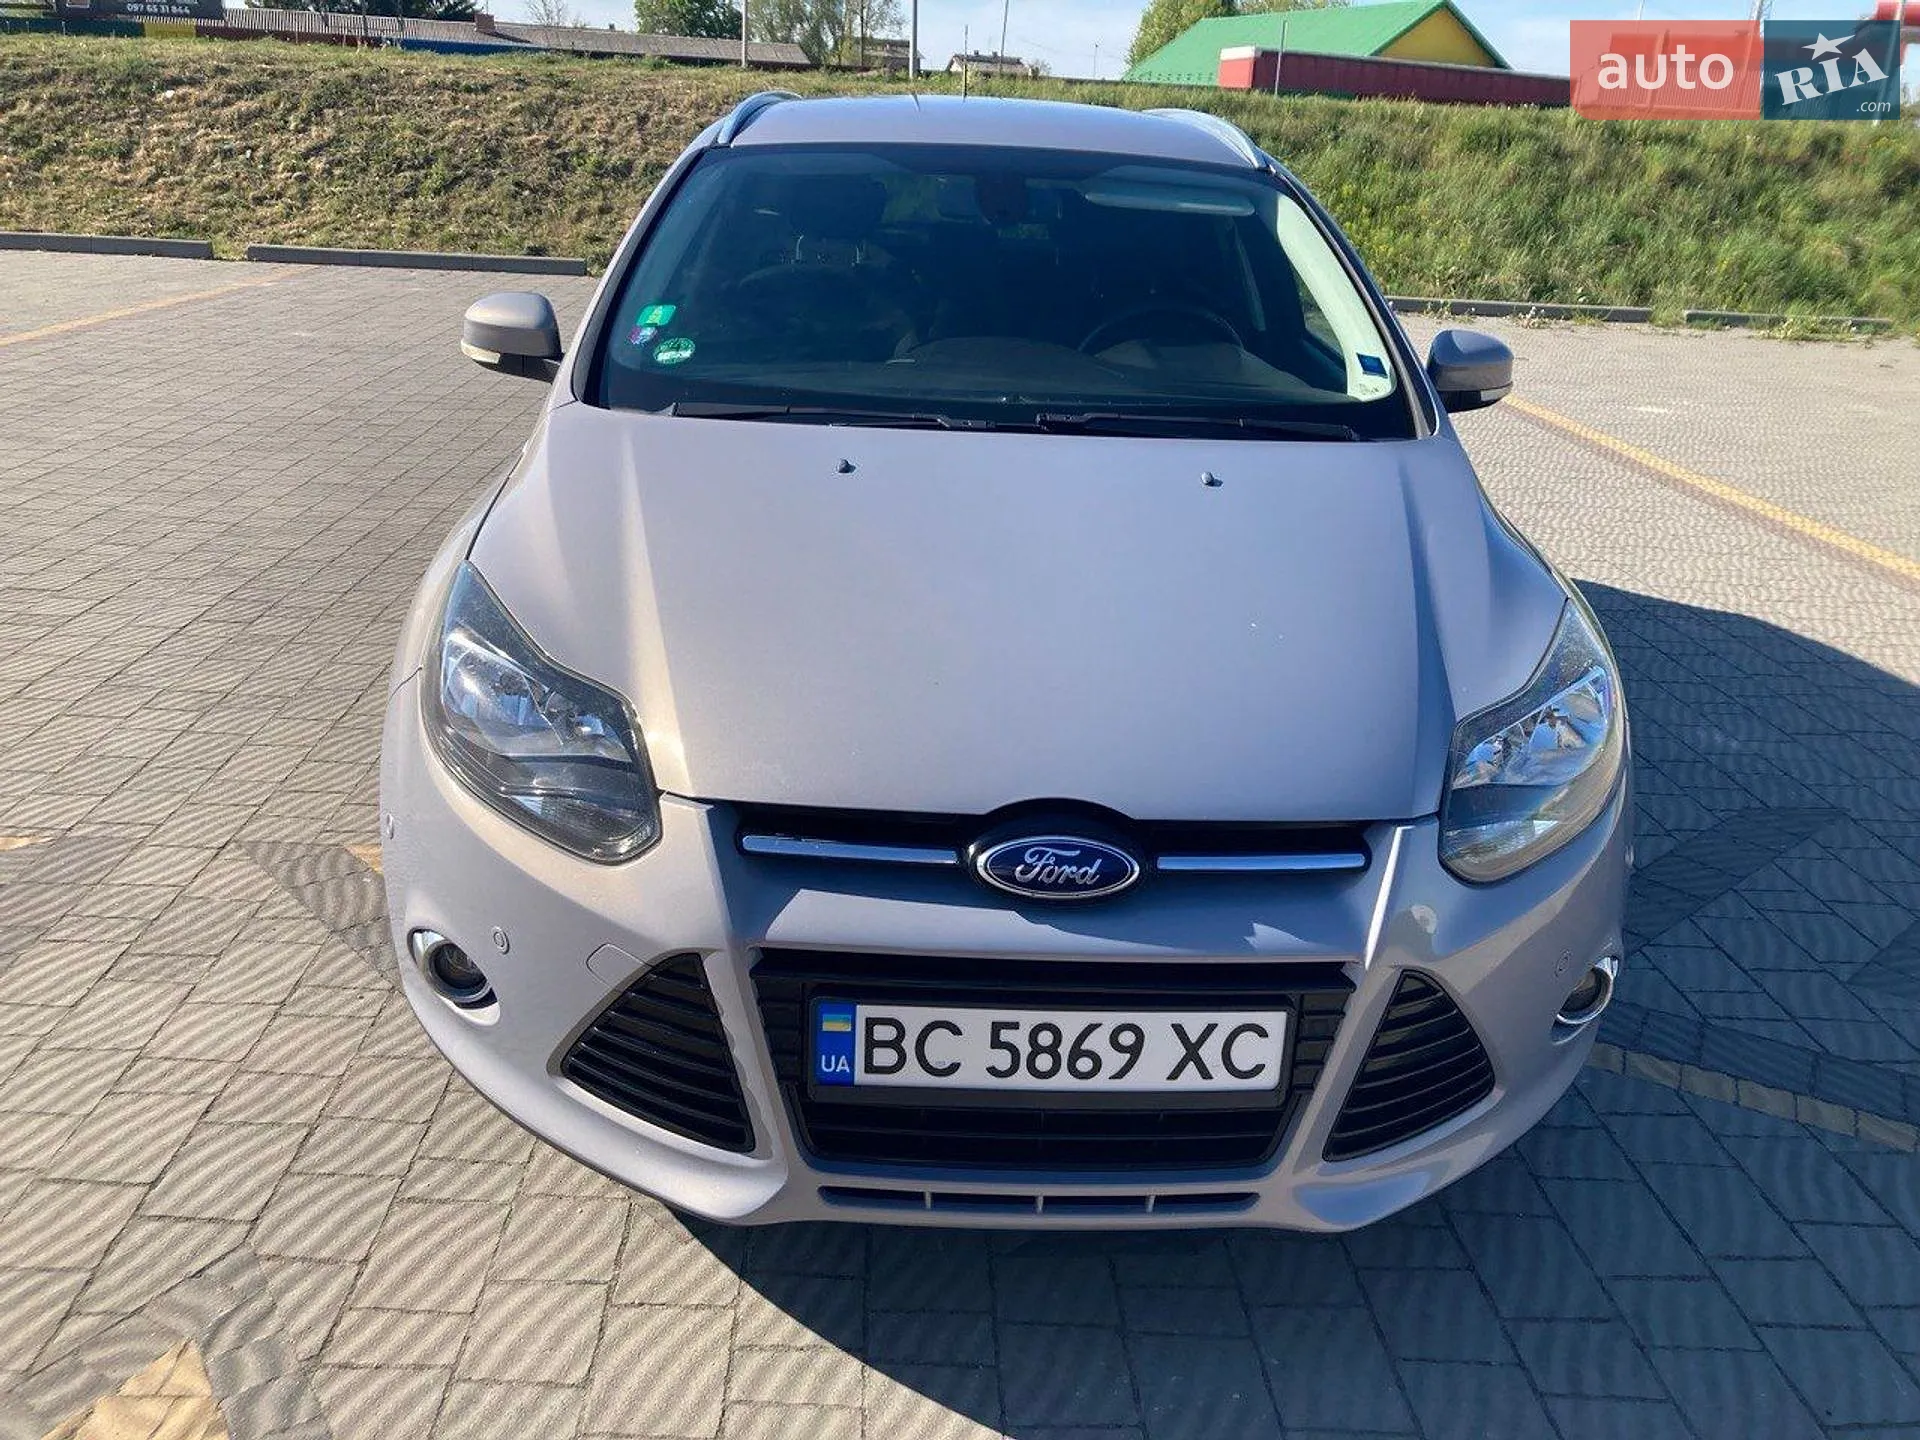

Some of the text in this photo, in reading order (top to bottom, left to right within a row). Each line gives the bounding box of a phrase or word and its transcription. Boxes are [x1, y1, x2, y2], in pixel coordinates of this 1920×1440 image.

[127, 3, 144, 12] 097
[1015, 847, 1102, 885] Ford
[864, 1017, 1270, 1081] BC 5869 XC
[820, 1054, 851, 1073] UA
